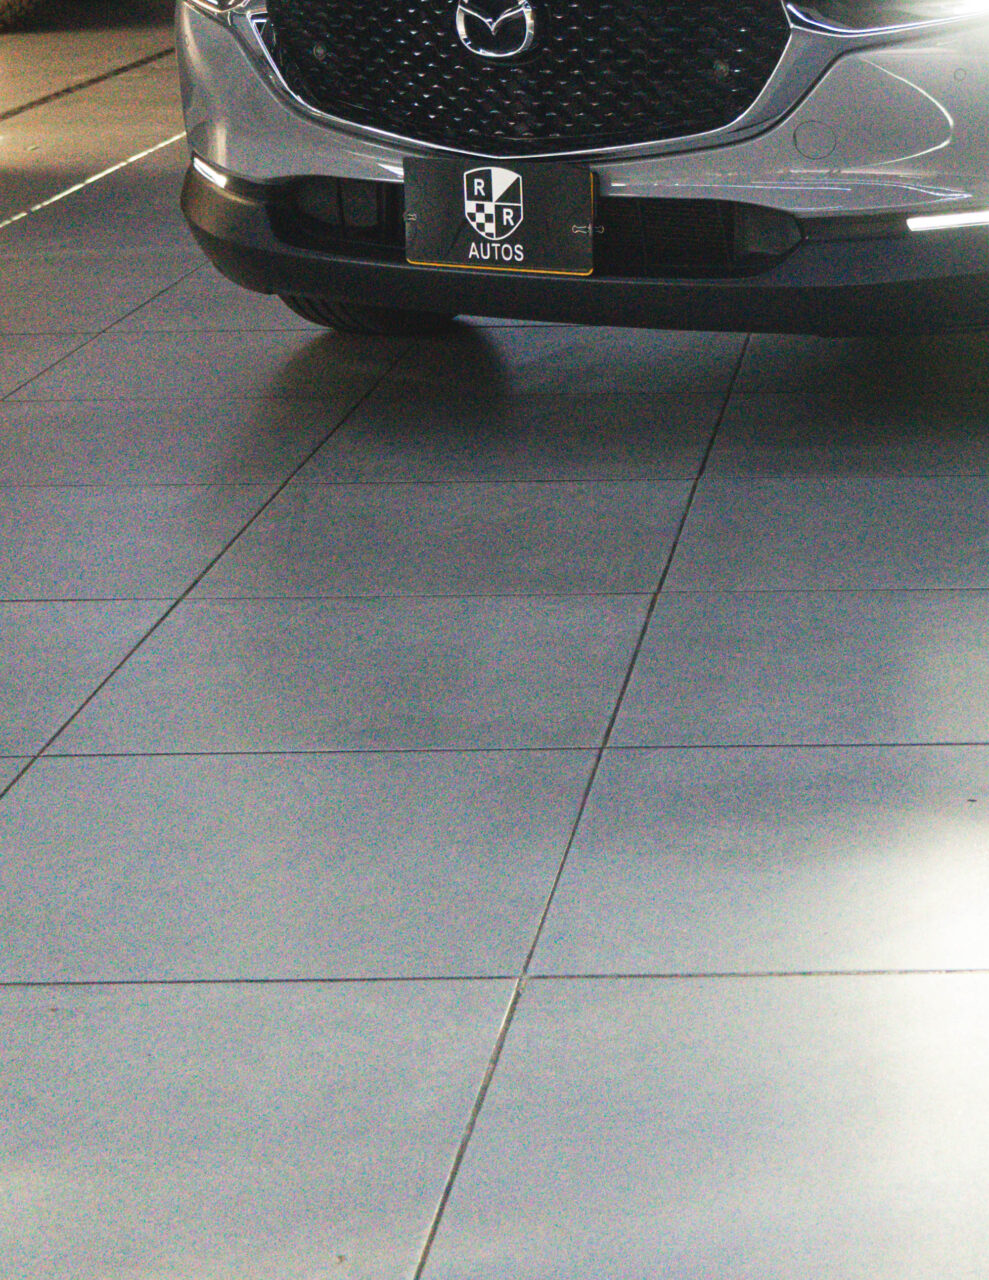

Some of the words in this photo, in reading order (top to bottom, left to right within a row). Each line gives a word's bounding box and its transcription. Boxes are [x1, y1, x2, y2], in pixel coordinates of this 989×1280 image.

[473, 178, 486, 196] R
[502, 208, 515, 226] R
[468, 242, 524, 261] AUTOS
